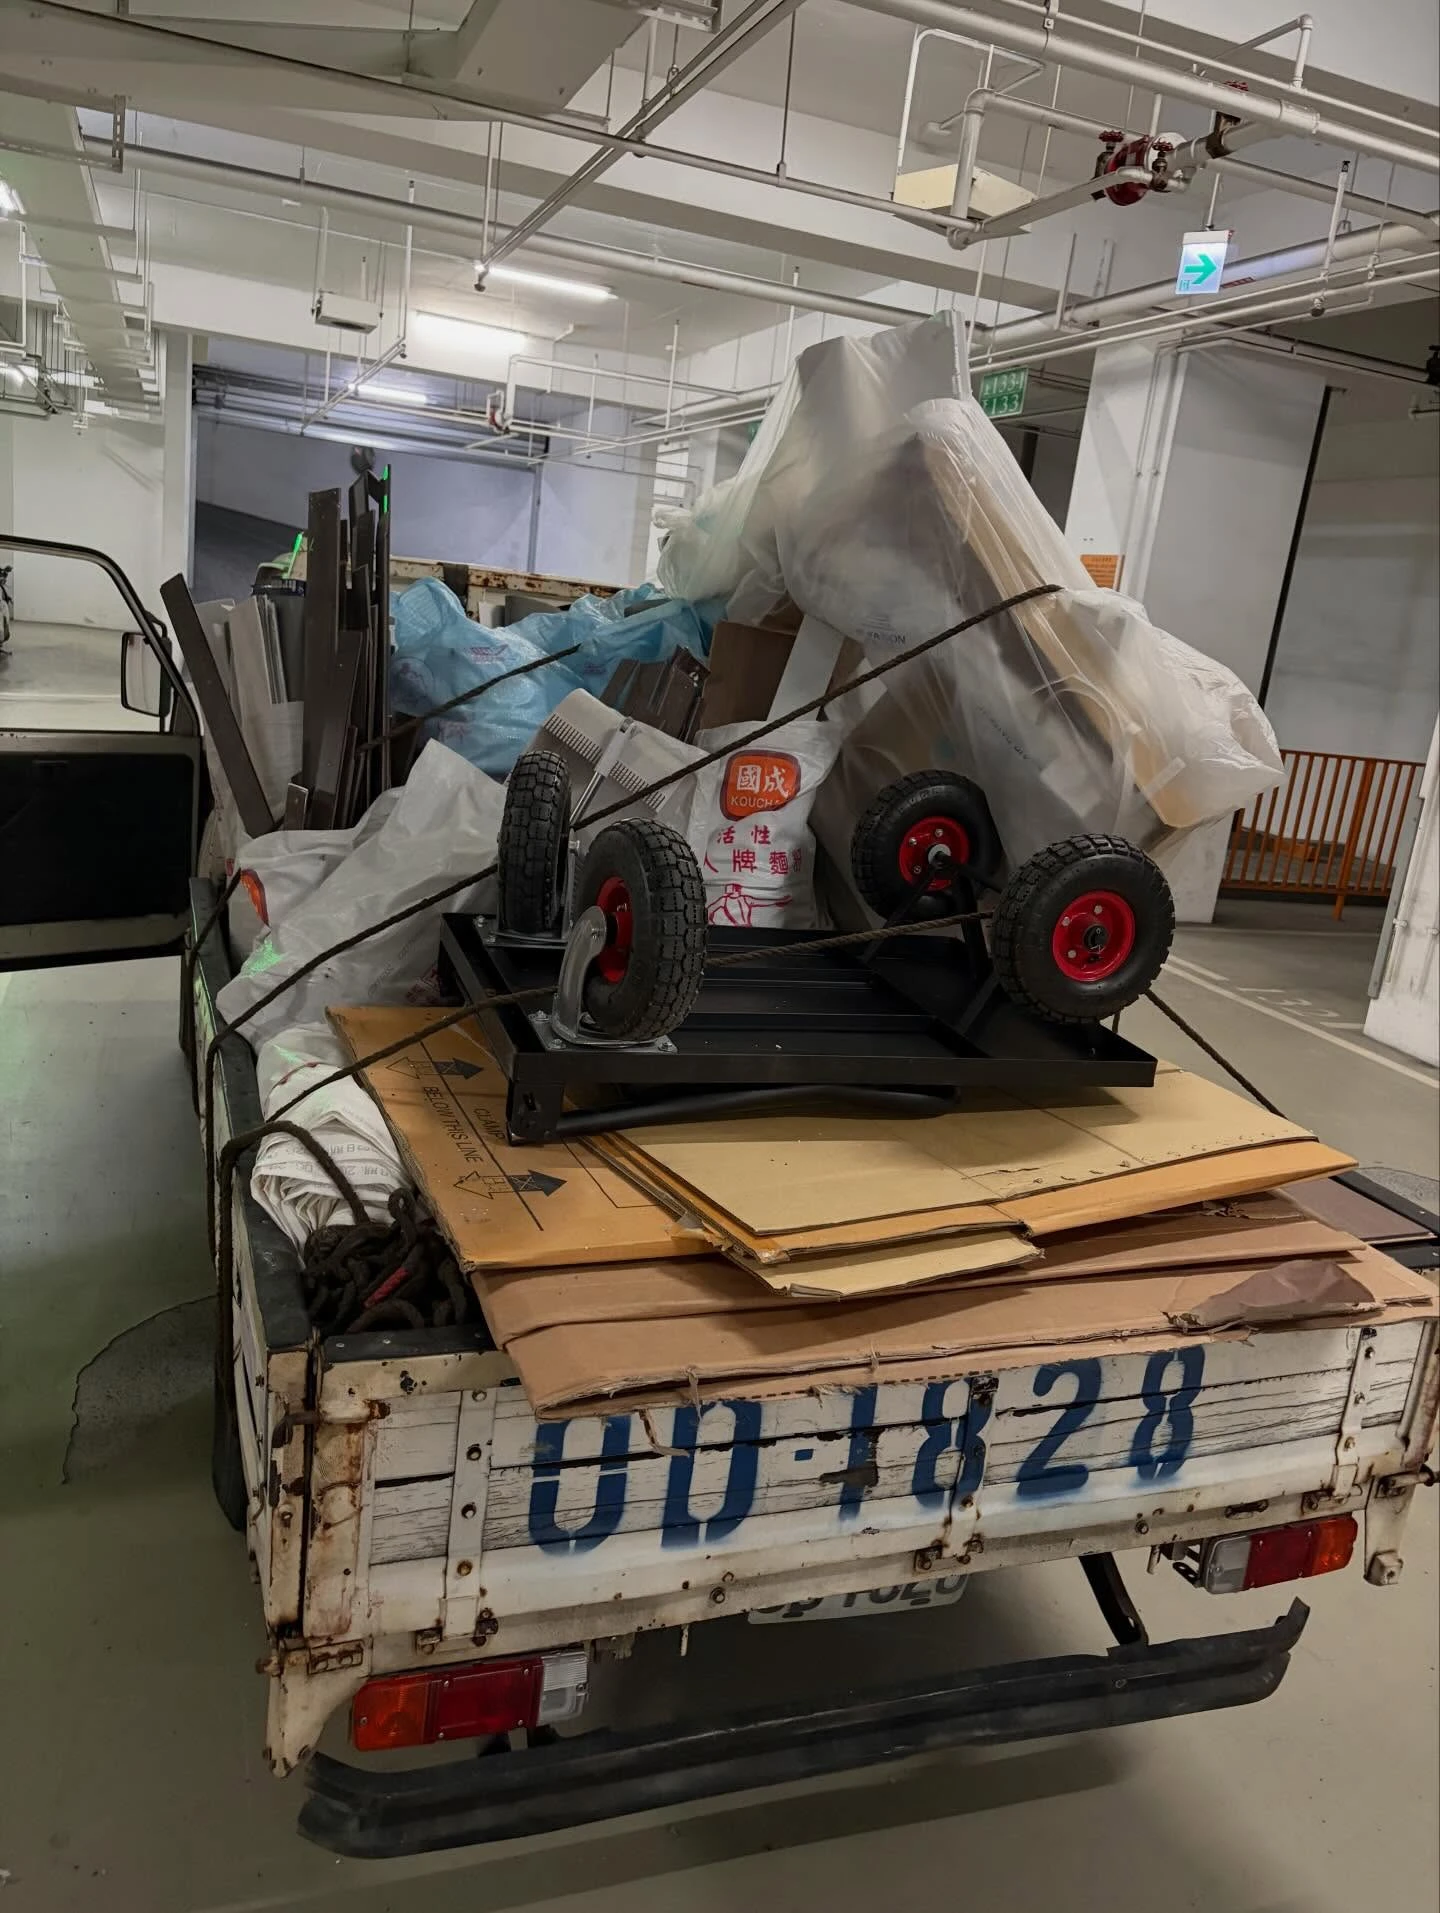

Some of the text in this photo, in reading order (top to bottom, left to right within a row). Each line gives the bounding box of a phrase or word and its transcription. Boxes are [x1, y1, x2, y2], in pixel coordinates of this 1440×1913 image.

[736, 764, 789, 799] 國成
[717, 825, 771, 844] 活性
[423, 1086, 484, 1162] BELOW THIS LINE
[473, 1107, 506, 1140] CLAMP
